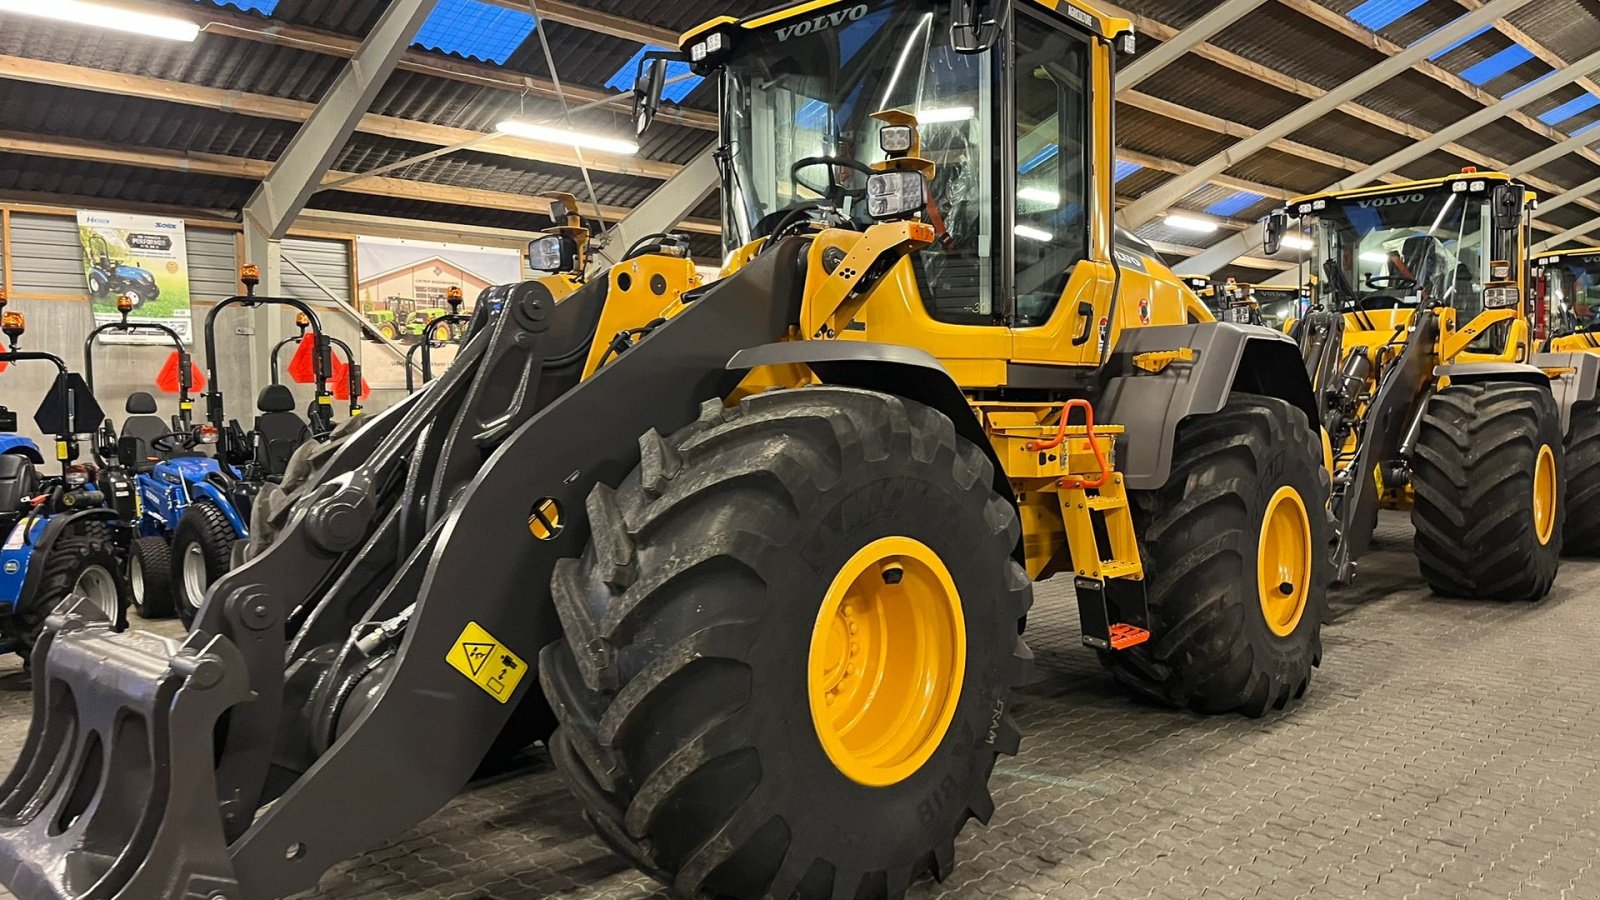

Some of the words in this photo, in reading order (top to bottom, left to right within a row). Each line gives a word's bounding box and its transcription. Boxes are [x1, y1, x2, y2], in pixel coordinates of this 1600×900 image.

[774, 4, 868, 42] VOLVO
[1356, 193, 1424, 209] VOLVO
[1114, 251, 1141, 267] LVO
